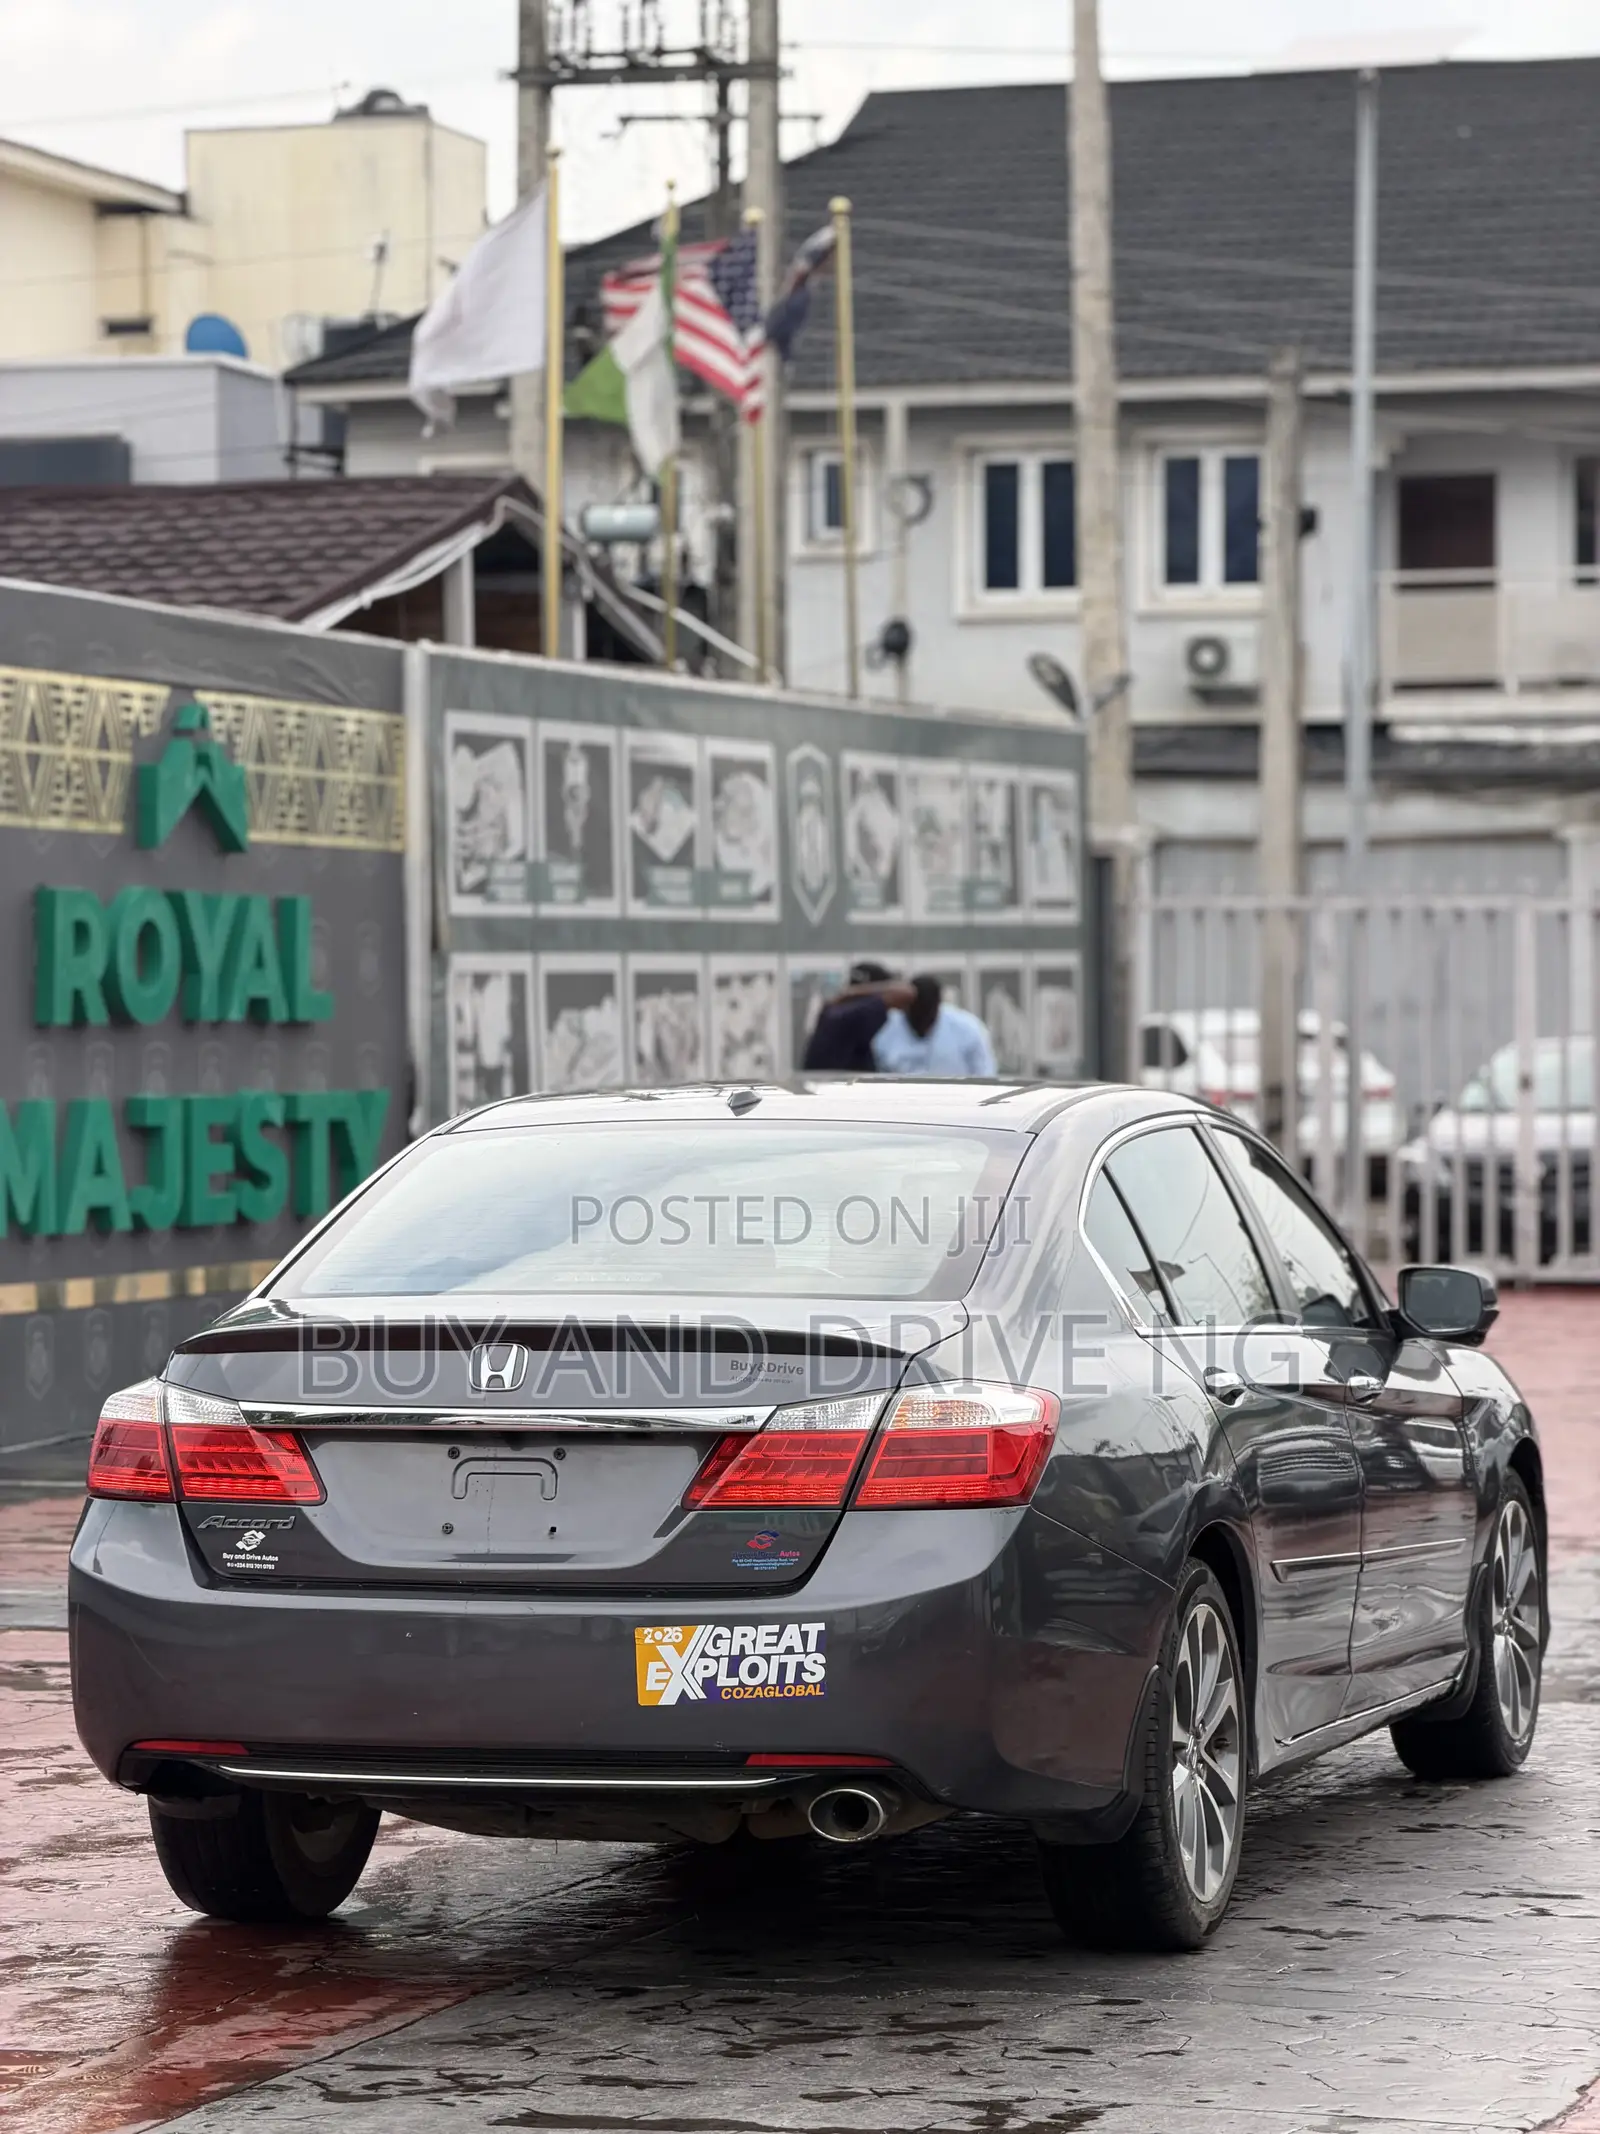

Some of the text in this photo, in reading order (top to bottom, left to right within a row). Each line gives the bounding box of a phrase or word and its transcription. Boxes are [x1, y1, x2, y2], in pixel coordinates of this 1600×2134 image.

[35, 884, 334, 1027] ROYAL
[0, 1088, 390, 1238] MAJESTY
[197, 1515, 296, 1529] Accord
[222, 1552, 234, 1561] Buy
[246, 1553, 261, 1561] Drive
[262, 1554, 279, 1562] Autos
[704, 1623, 826, 1657] GREAT
[721, 1684, 825, 1700] COZAGLOBAL
